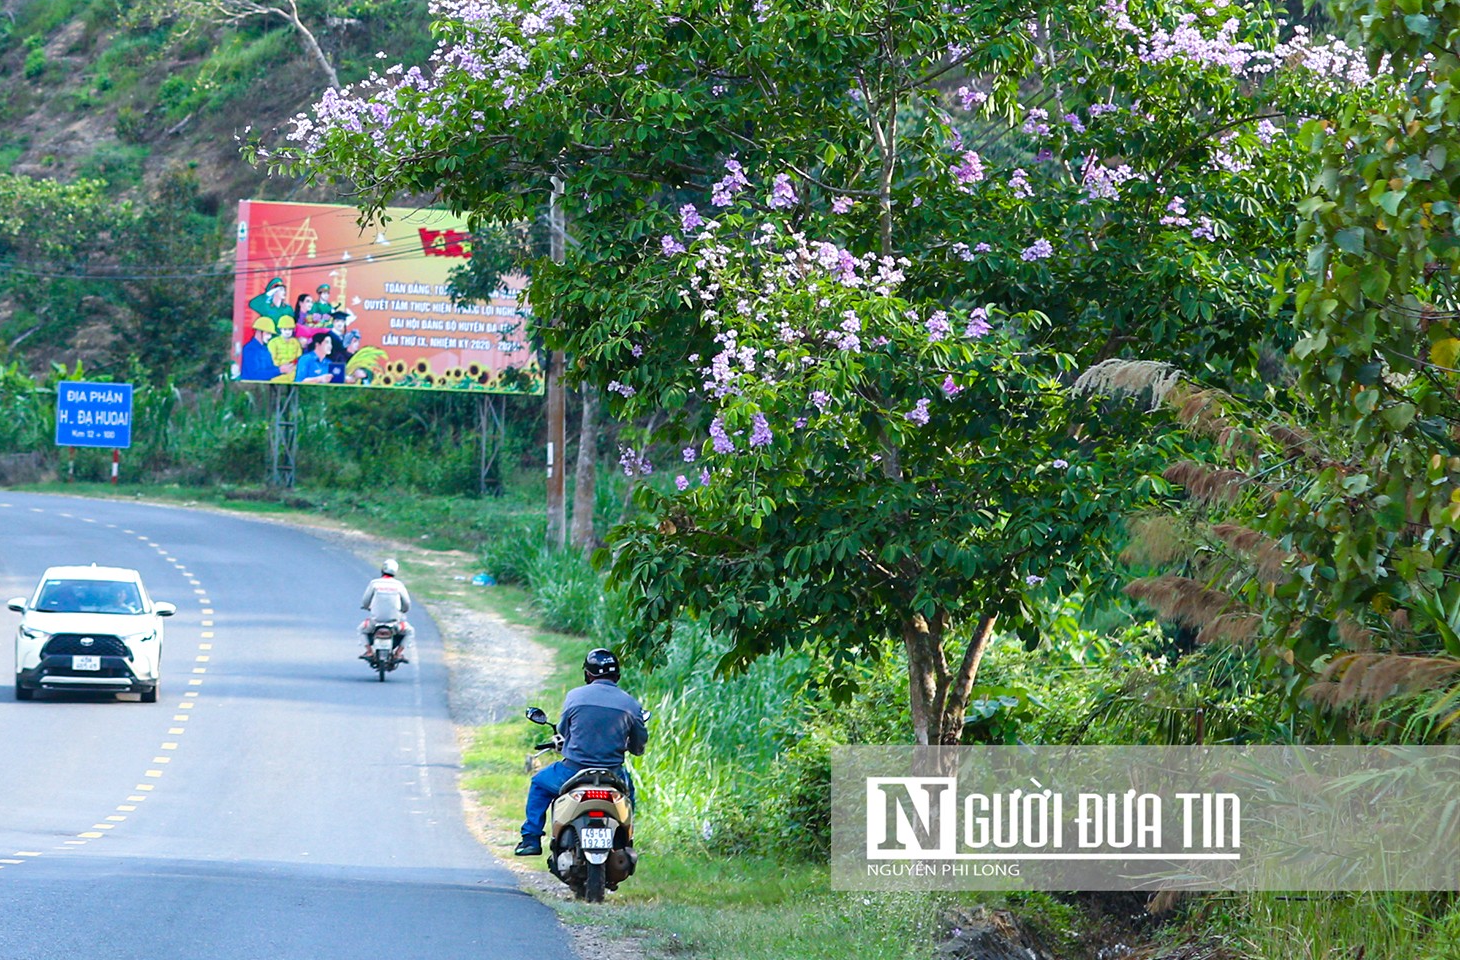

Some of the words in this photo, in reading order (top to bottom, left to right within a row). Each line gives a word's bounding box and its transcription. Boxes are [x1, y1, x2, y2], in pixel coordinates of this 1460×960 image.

[385, 282, 407, 294] TOÀN
[364, 298, 389, 310] QUYẾT
[391, 300, 409, 311] TÂM
[410, 301, 431, 313] THỰC
[432, 302, 452, 313] HIỆN
[405, 318, 420, 330] HỘI
[421, 319, 444, 330] ĐẢNG
[445, 320, 457, 331] BỘ
[458, 321, 485, 333] HUYỆN
[382, 333, 399, 345] LẦN
[400, 335, 417, 346] THỨ
[430, 337, 457, 348] NHIỆM
[470, 339, 491, 349] 2020
[67, 390, 87, 403] ĐỊA
[90, 390, 123, 404] PHẬN
[77, 410, 93, 426] ĐẠ
[95, 411, 128, 426] HUOAI
